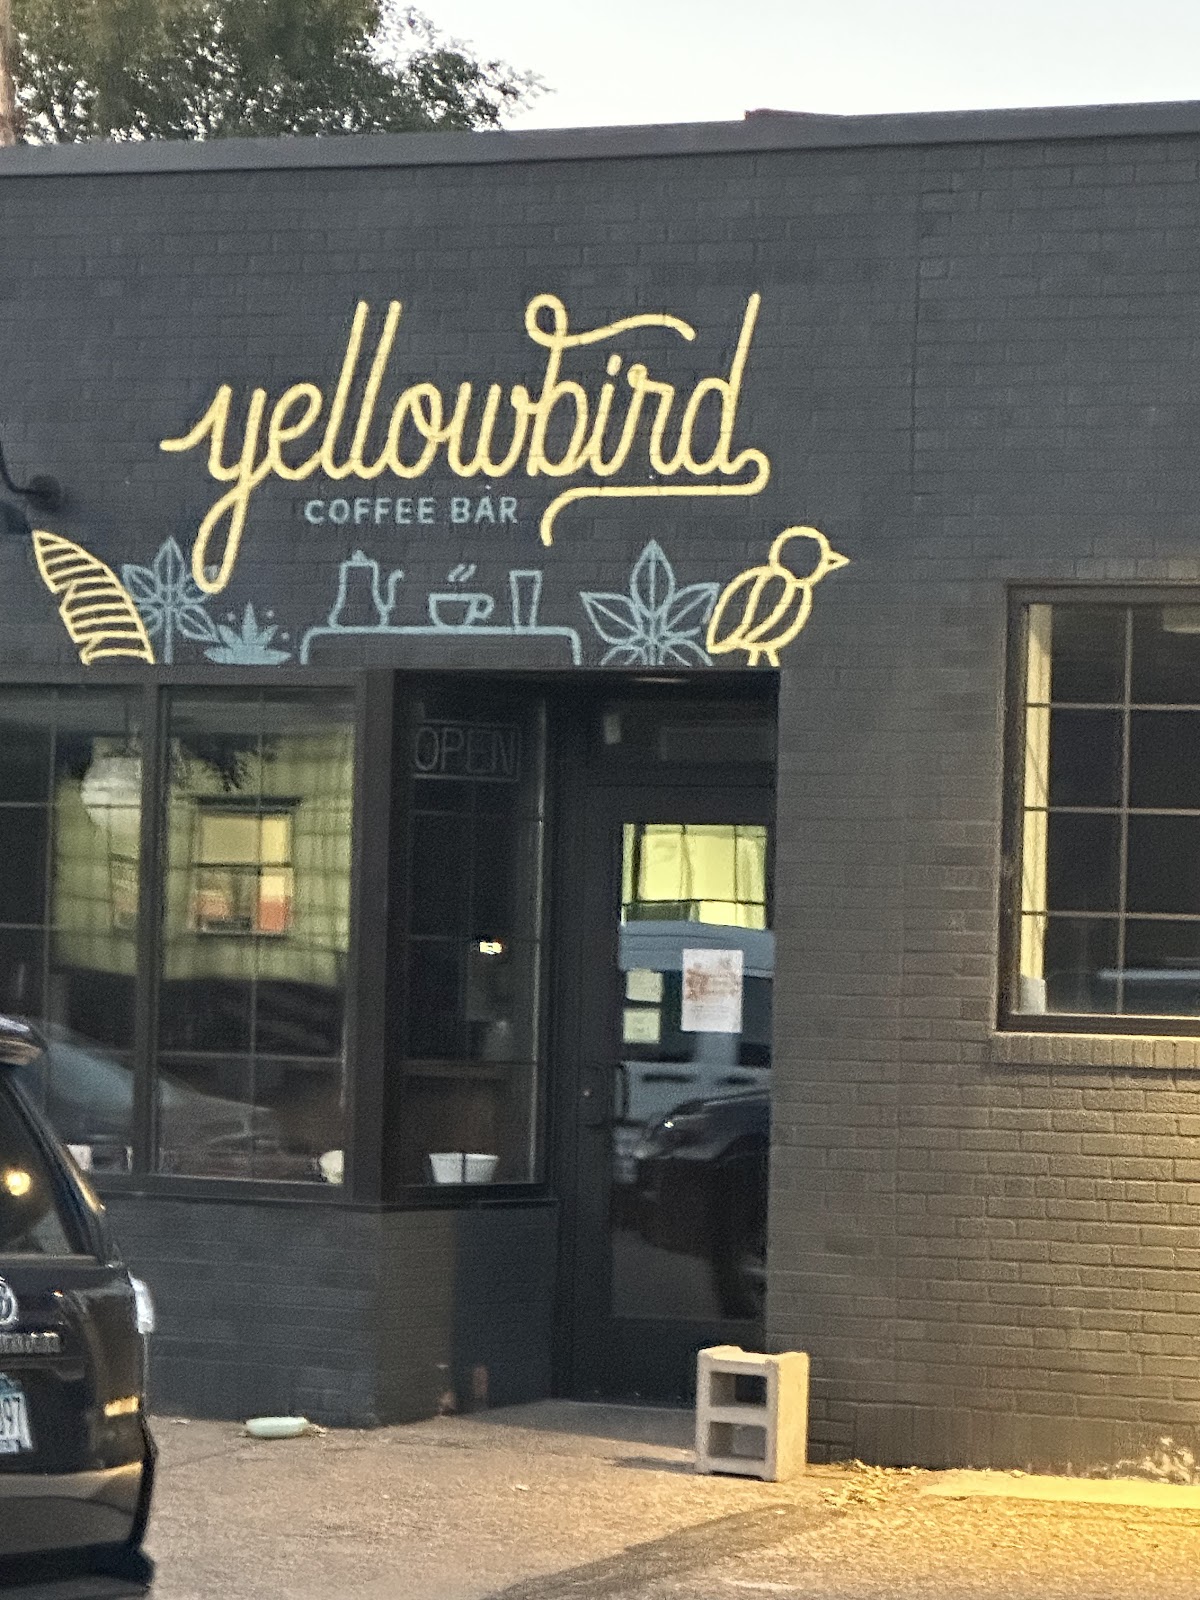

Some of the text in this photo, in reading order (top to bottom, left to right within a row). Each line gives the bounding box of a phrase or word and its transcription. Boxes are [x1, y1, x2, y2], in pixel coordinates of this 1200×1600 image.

[159, 293, 770, 595] yellowbird
[304, 496, 518, 525] COFFEE BAR
[414, 726, 515, 775] OPEN
